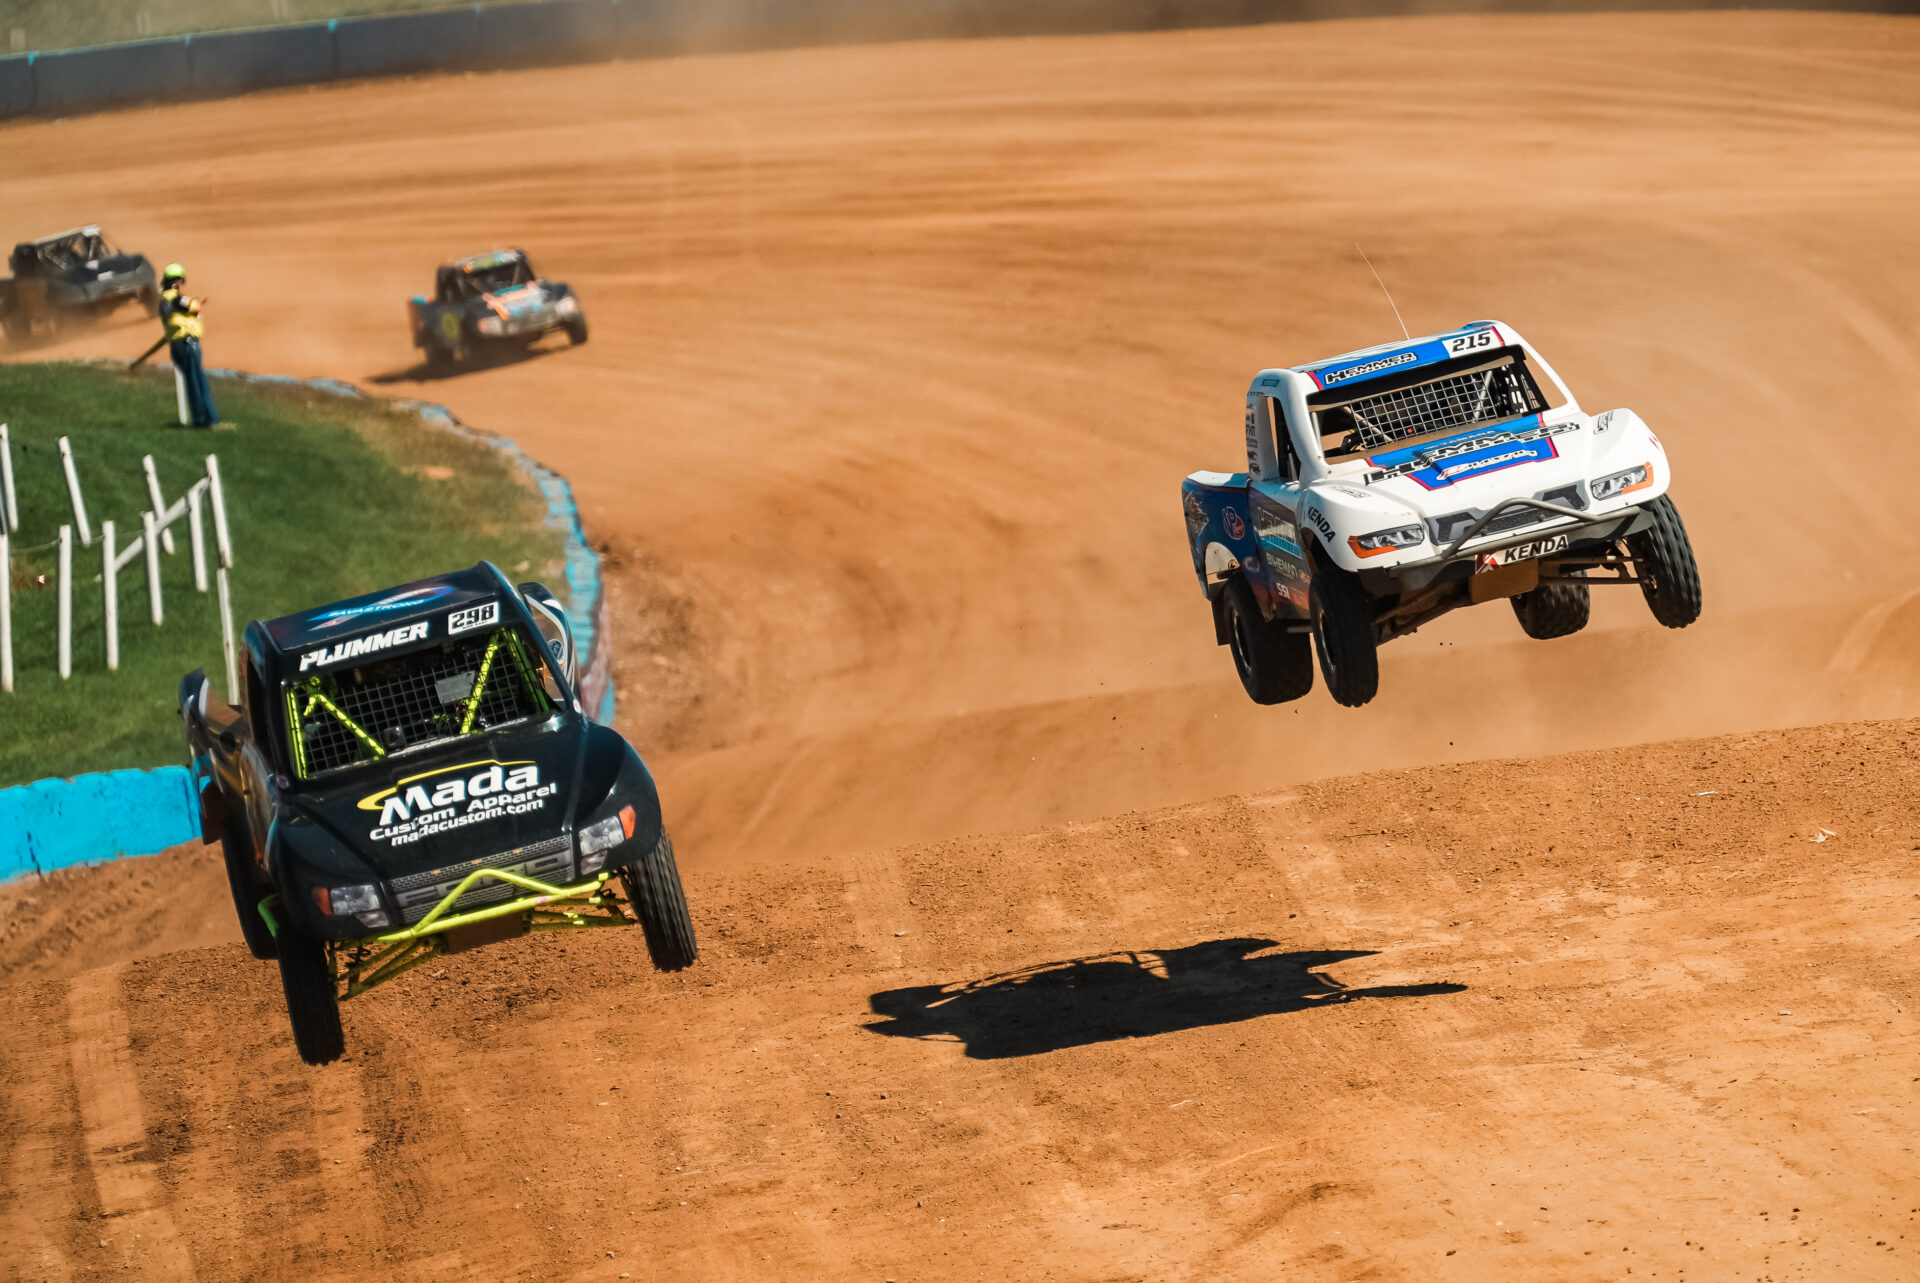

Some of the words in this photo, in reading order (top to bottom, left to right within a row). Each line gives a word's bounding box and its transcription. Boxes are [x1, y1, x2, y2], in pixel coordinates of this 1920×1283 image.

[1452, 331, 1491, 352] 215
[1325, 352, 1418, 385] HEMMER
[1307, 506, 1336, 543] KENDA
[1503, 535, 1568, 563] KENDA
[451, 604, 495, 629] 298
[299, 621, 431, 672] PLUMMER
[369, 808, 455, 841] Custom
[467, 782, 557, 813] Apparel
[379, 765, 540, 826] Mada
[391, 799, 544, 847] madacustom.com
